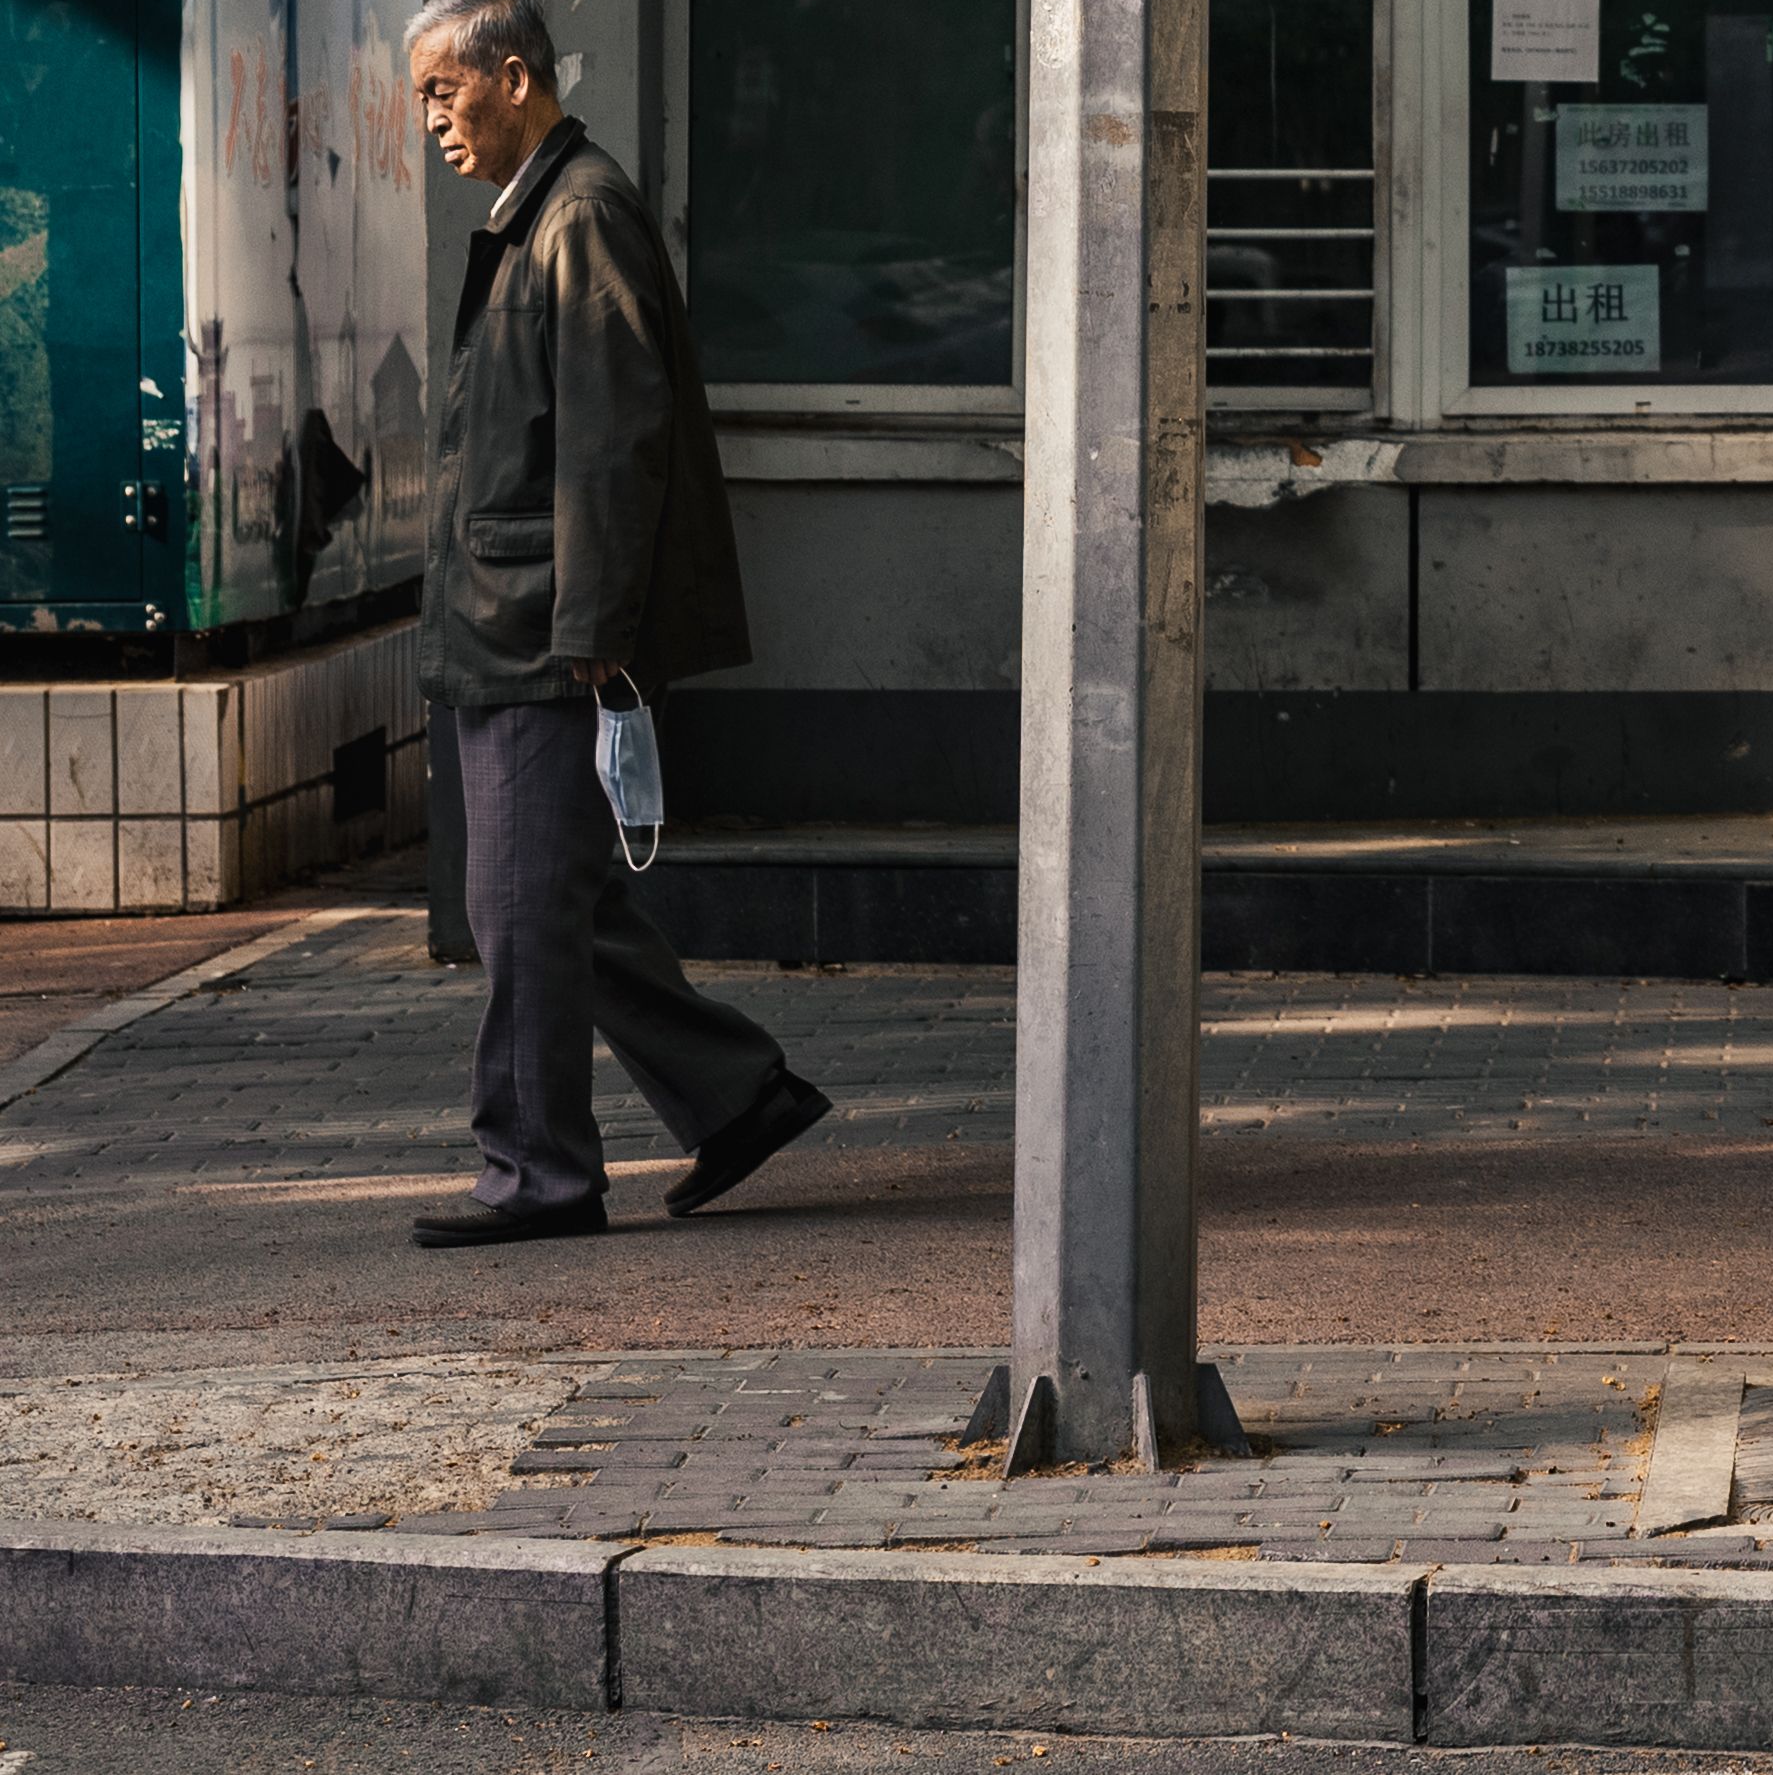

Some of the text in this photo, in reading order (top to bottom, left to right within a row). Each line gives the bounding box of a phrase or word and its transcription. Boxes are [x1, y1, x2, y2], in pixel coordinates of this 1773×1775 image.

[1576, 121, 1691, 150] 此房出租
[1579, 159, 1689, 175] 15637205202
[1579, 185, 1688, 199] 15518898631
[1541, 282, 1629, 325] 出租
[1524, 339, 1645, 357] 18738255205
